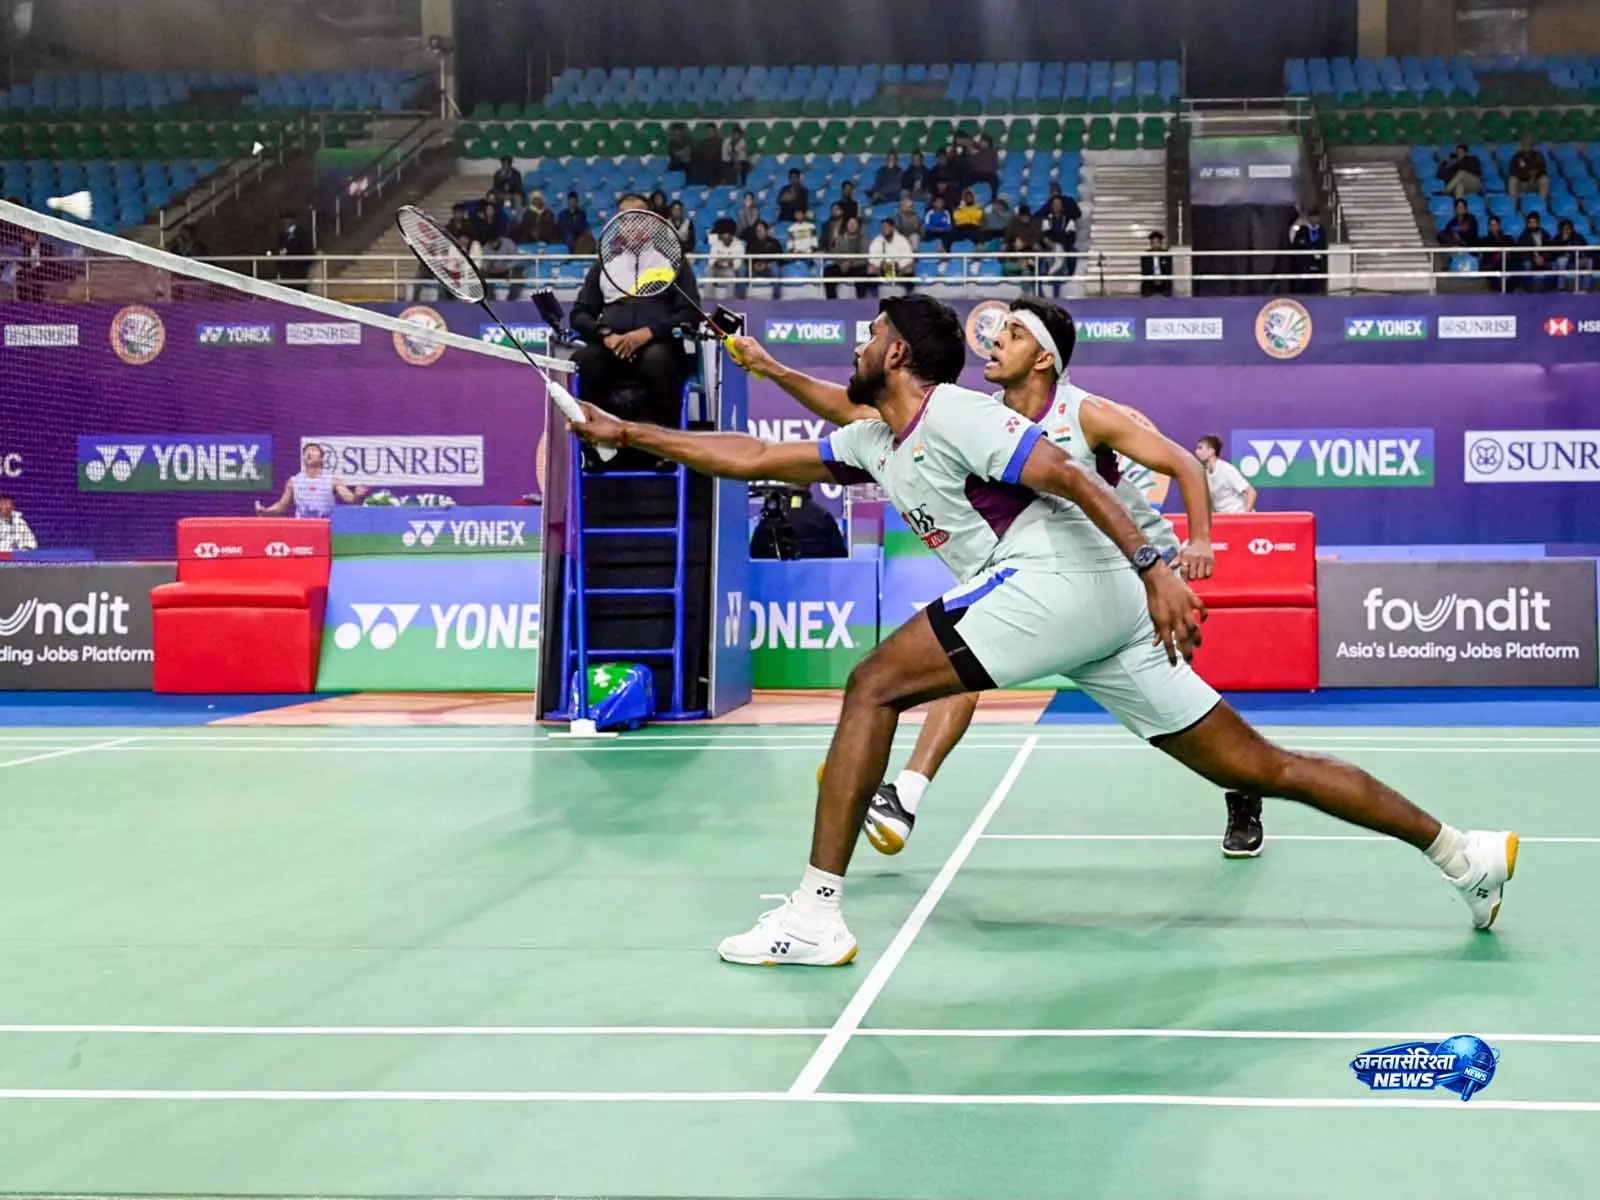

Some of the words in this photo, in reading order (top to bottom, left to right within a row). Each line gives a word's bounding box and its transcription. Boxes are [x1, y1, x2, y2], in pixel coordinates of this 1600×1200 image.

[227, 325, 271, 343] YONEX
[796, 323, 841, 341] YONEX
[1086, 320, 1130, 338] YONEX
[1163, 321, 1221, 336] SUNRISE
[1376, 320, 1422, 337] YONEX
[1456, 319, 1514, 334] SUNRISE
[152, 444, 260, 481] YONEX
[342, 446, 479, 474] SUNRISE
[1309, 439, 1421, 477] YONEX
[1507, 441, 1600, 470] SUNR
[450, 520, 525, 547] YONEX
[1363, 587, 1552, 632] foundit
[37, 645, 79, 662] Jobs
[82, 645, 155, 662] Platform
[1336, 642, 1385, 660] Asia's
[1389, 642, 1456, 663] Leading
[1460, 642, 1503, 660] Jobs
[1506, 642, 1580, 660] Platform
